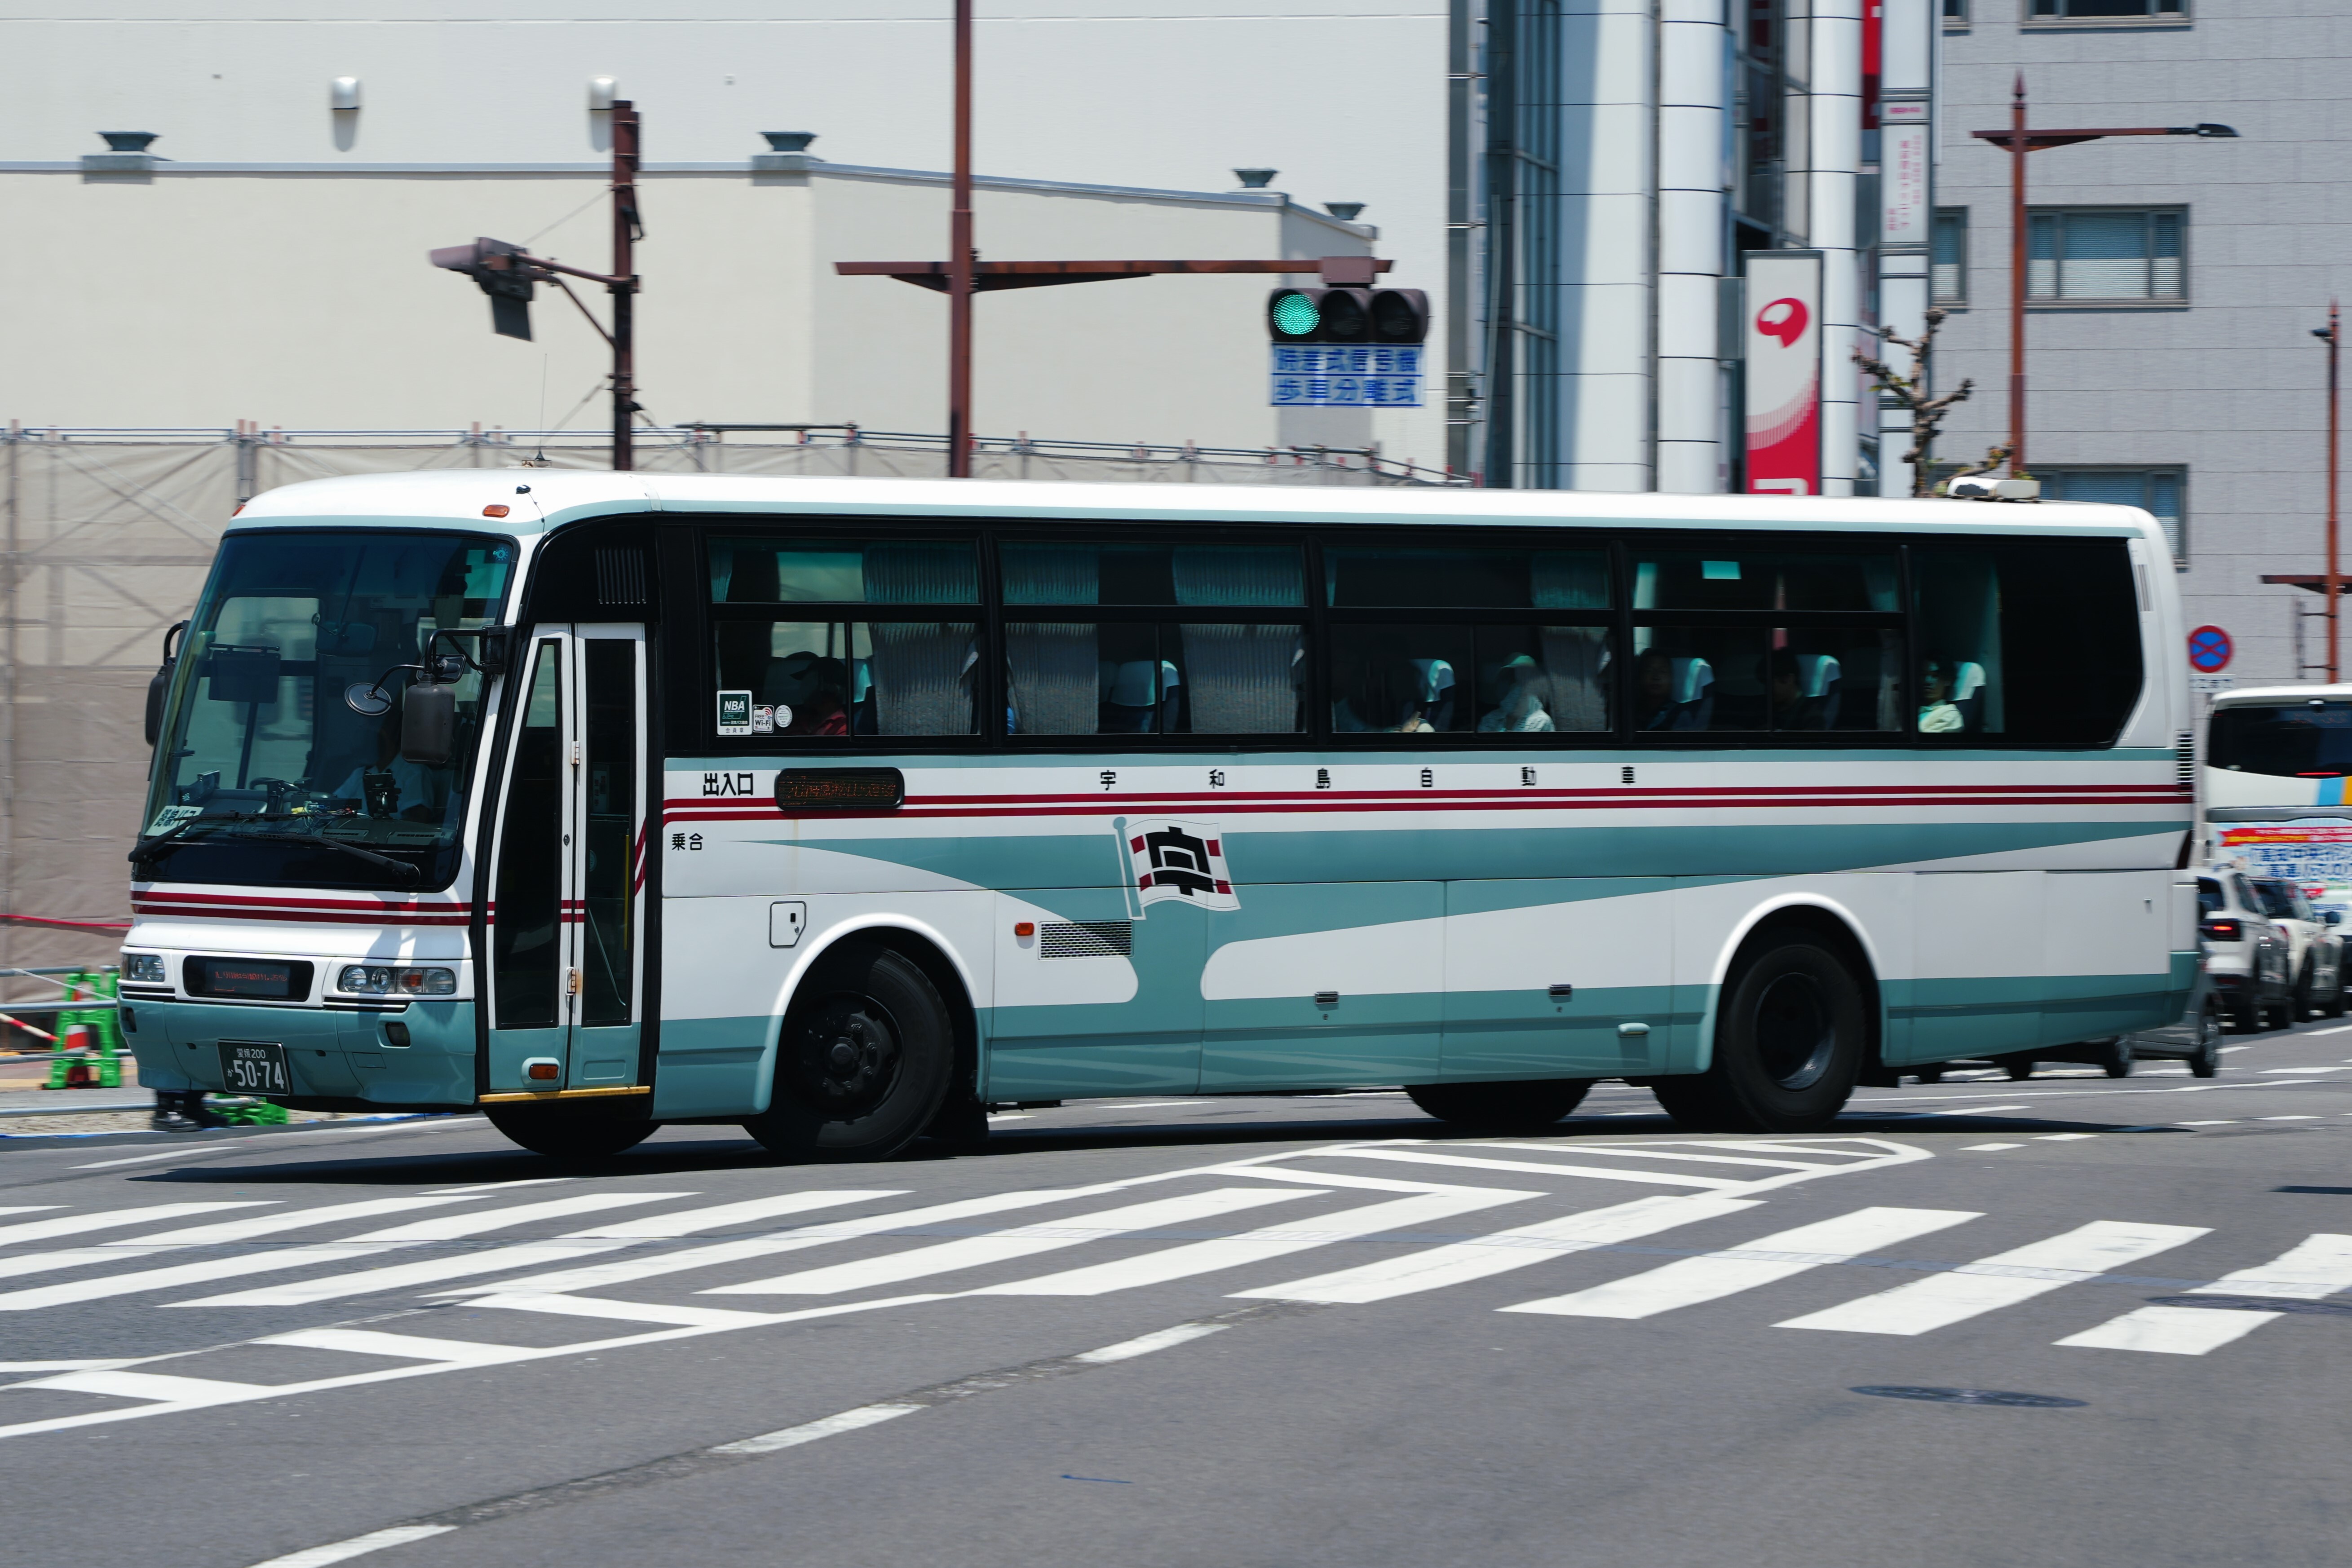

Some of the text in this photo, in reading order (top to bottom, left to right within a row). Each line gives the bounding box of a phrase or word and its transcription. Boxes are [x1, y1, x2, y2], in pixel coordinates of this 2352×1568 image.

[1276, 347, 1418, 372] 時差式信号機
[1276, 378, 1416, 402] 歩車分離式
[724, 701, 745, 710] NBA
[703, 773, 753, 796] 出入口
[672, 833, 703, 851] 乗合
[236, 1048, 266, 1059] 愛媛200
[227, 1060, 284, 1089] か 50-74
